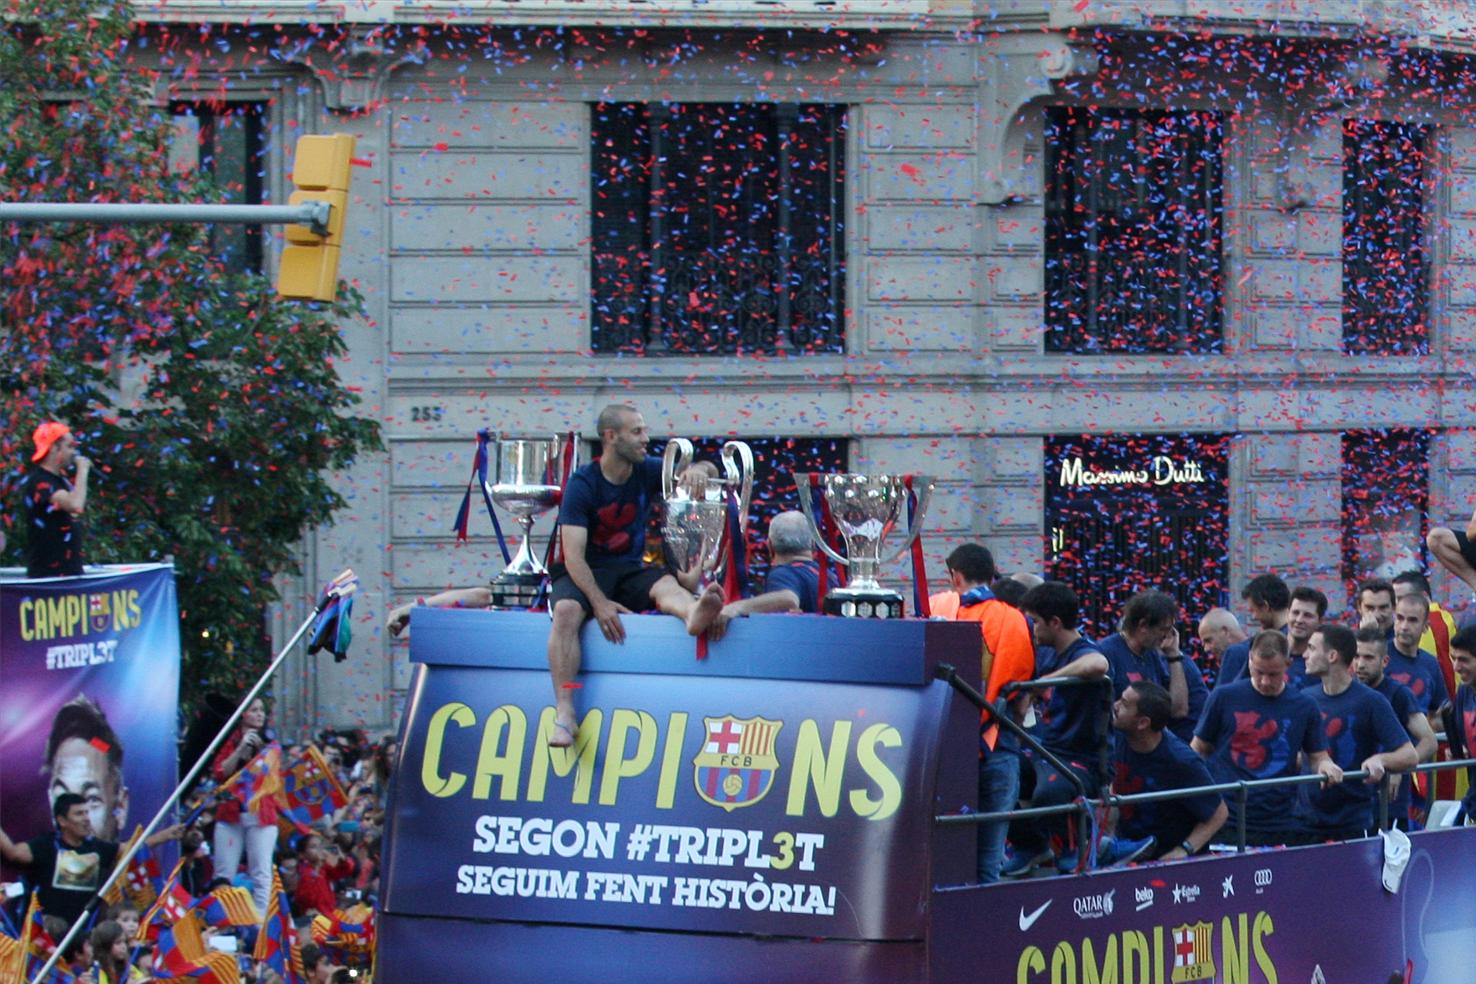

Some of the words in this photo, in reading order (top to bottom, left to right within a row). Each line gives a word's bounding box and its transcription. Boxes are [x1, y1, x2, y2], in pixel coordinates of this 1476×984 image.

[1060, 457, 1149, 487] Massimo
[1153, 455, 1205, 486] Dutti
[19, 589, 142, 642] CAMPINS
[46, 639, 118, 670] #TRIPL3T
[420, 701, 903, 822] CAMPINS
[473, 815, 620, 861] SEGON
[626, 824, 825, 872] #TRIPL3T
[456, 865, 579, 900] SEGUIM
[584, 873, 668, 905] FENT
[671, 874, 836, 916] HISTÒRIA!
[1073, 895, 1103, 916] QATAR
[1135, 887, 1153, 902] beko
